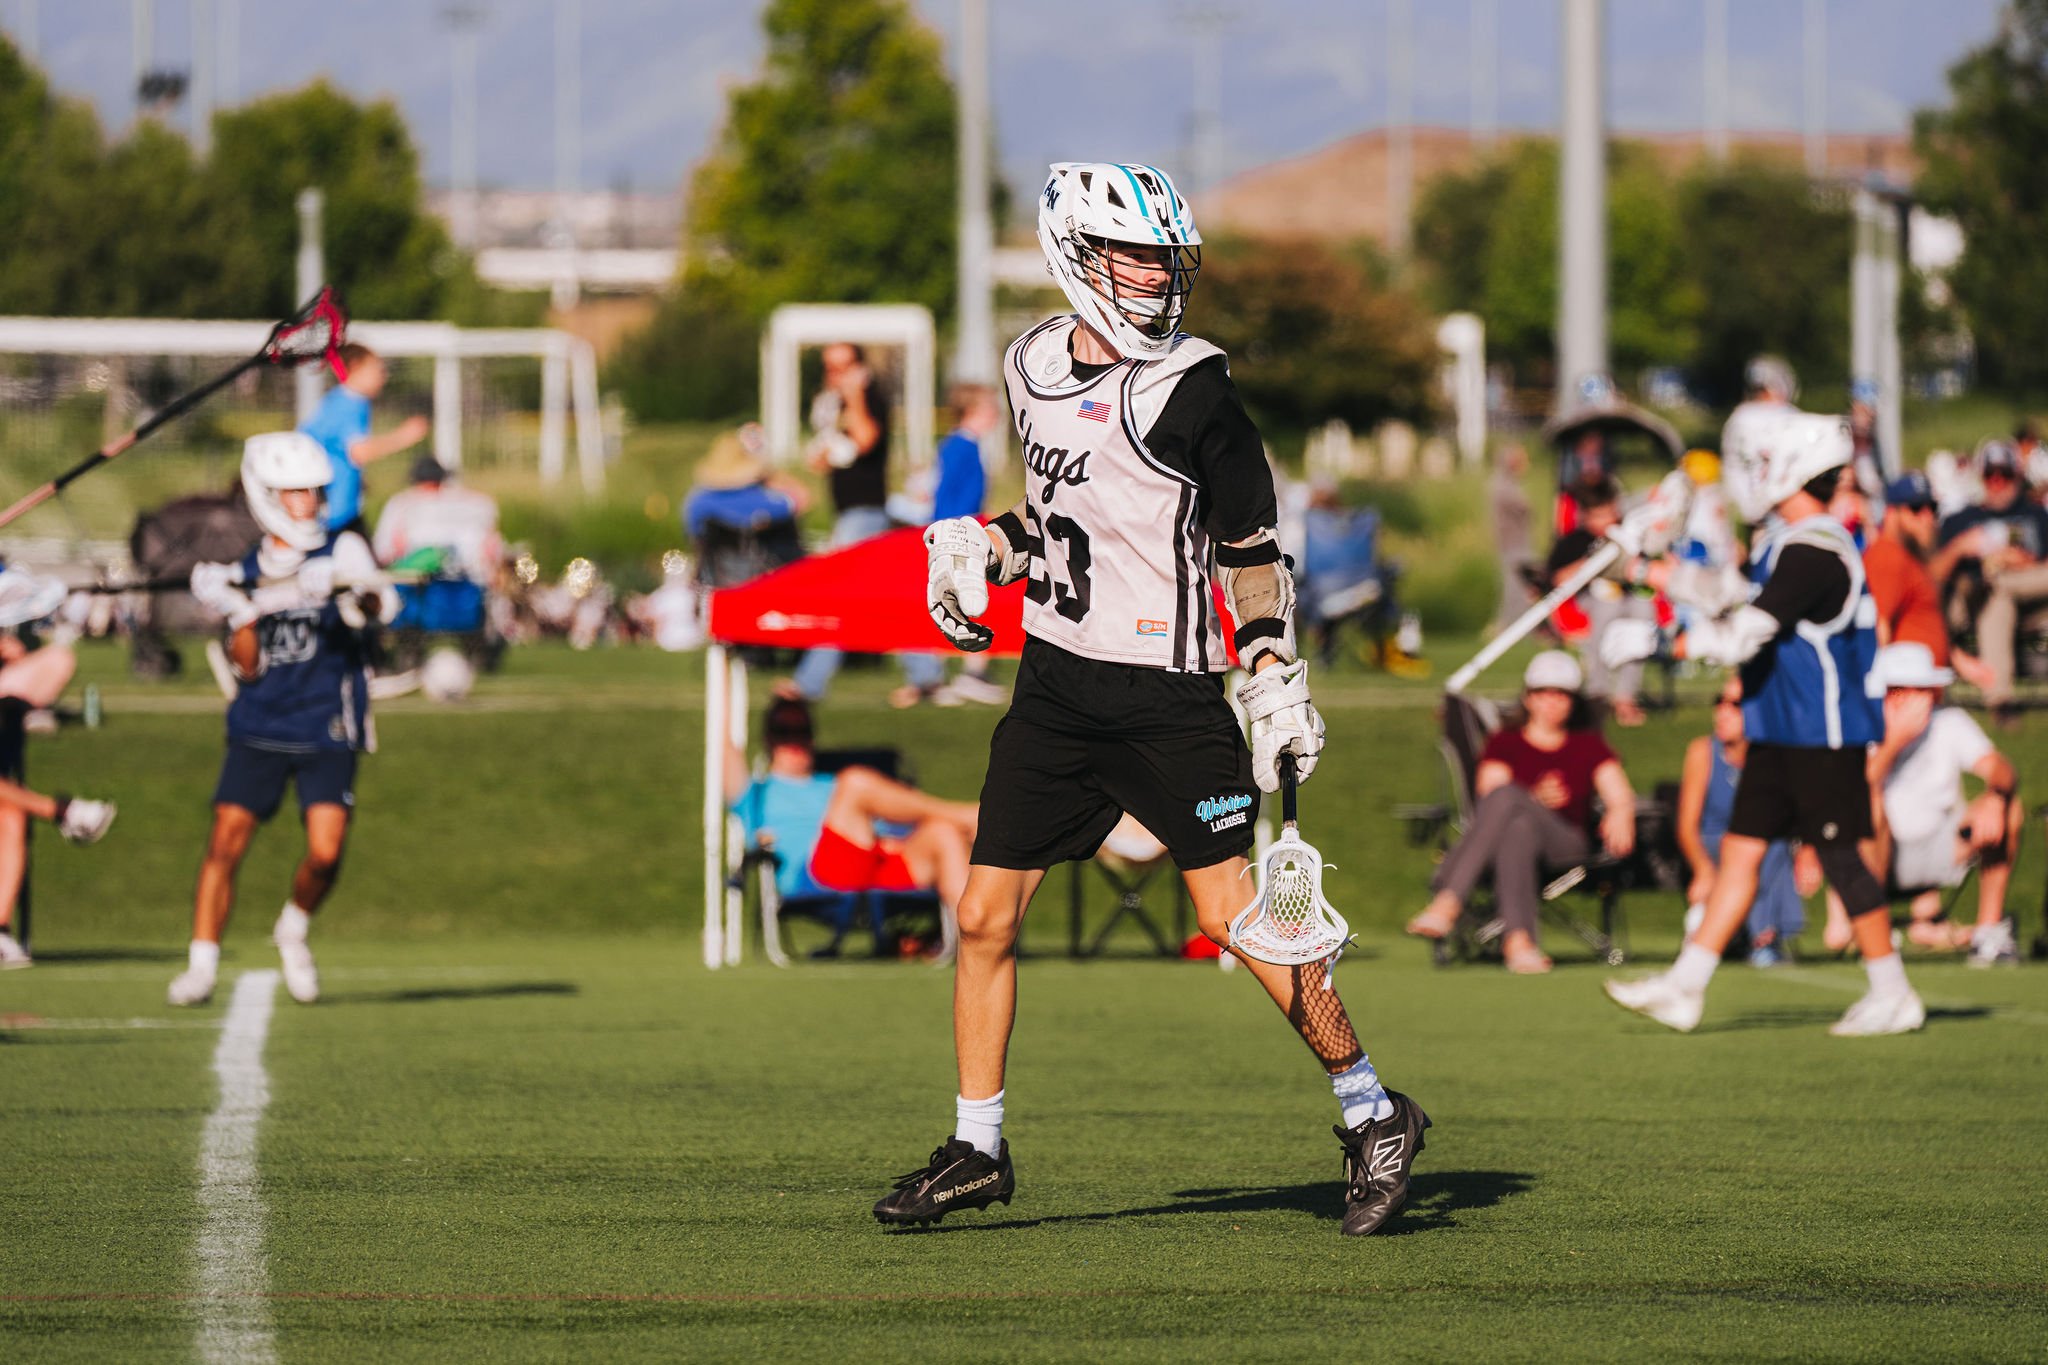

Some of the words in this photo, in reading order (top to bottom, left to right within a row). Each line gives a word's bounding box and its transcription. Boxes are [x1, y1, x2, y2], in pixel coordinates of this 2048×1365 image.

[1019, 408, 1091, 505] tags
[1210, 811, 1247, 833] LACROSSE
[932, 1188, 955, 1204] new
[954, 1171, 1000, 1196] balance
